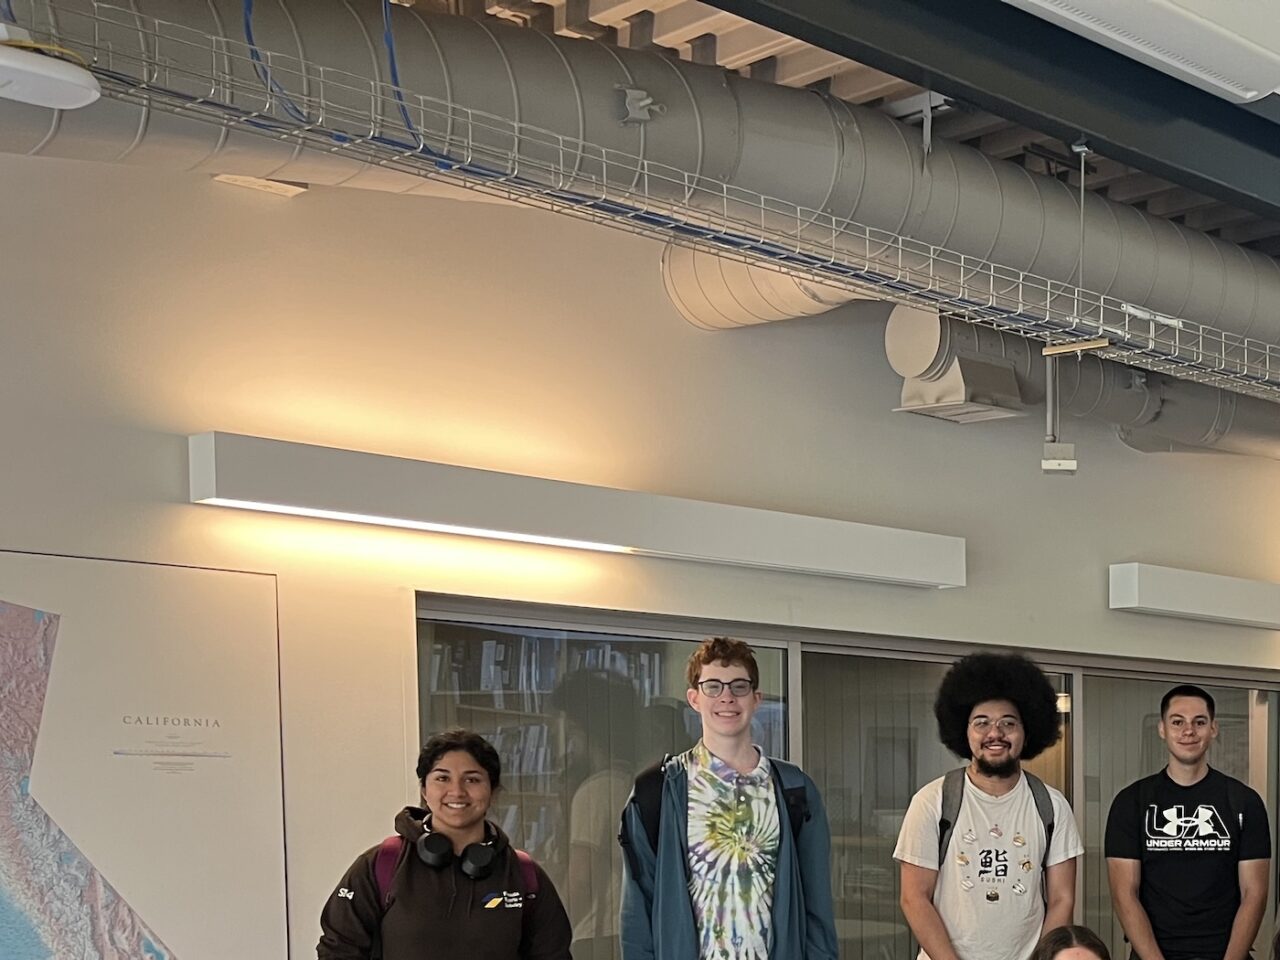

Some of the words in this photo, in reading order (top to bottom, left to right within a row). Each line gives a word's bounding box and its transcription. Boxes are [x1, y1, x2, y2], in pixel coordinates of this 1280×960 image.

[122, 715, 221, 728] CALIFORNIA
[1146, 839, 1182, 848] UNDER
[1183, 839, 1231, 848] ARMOUR
